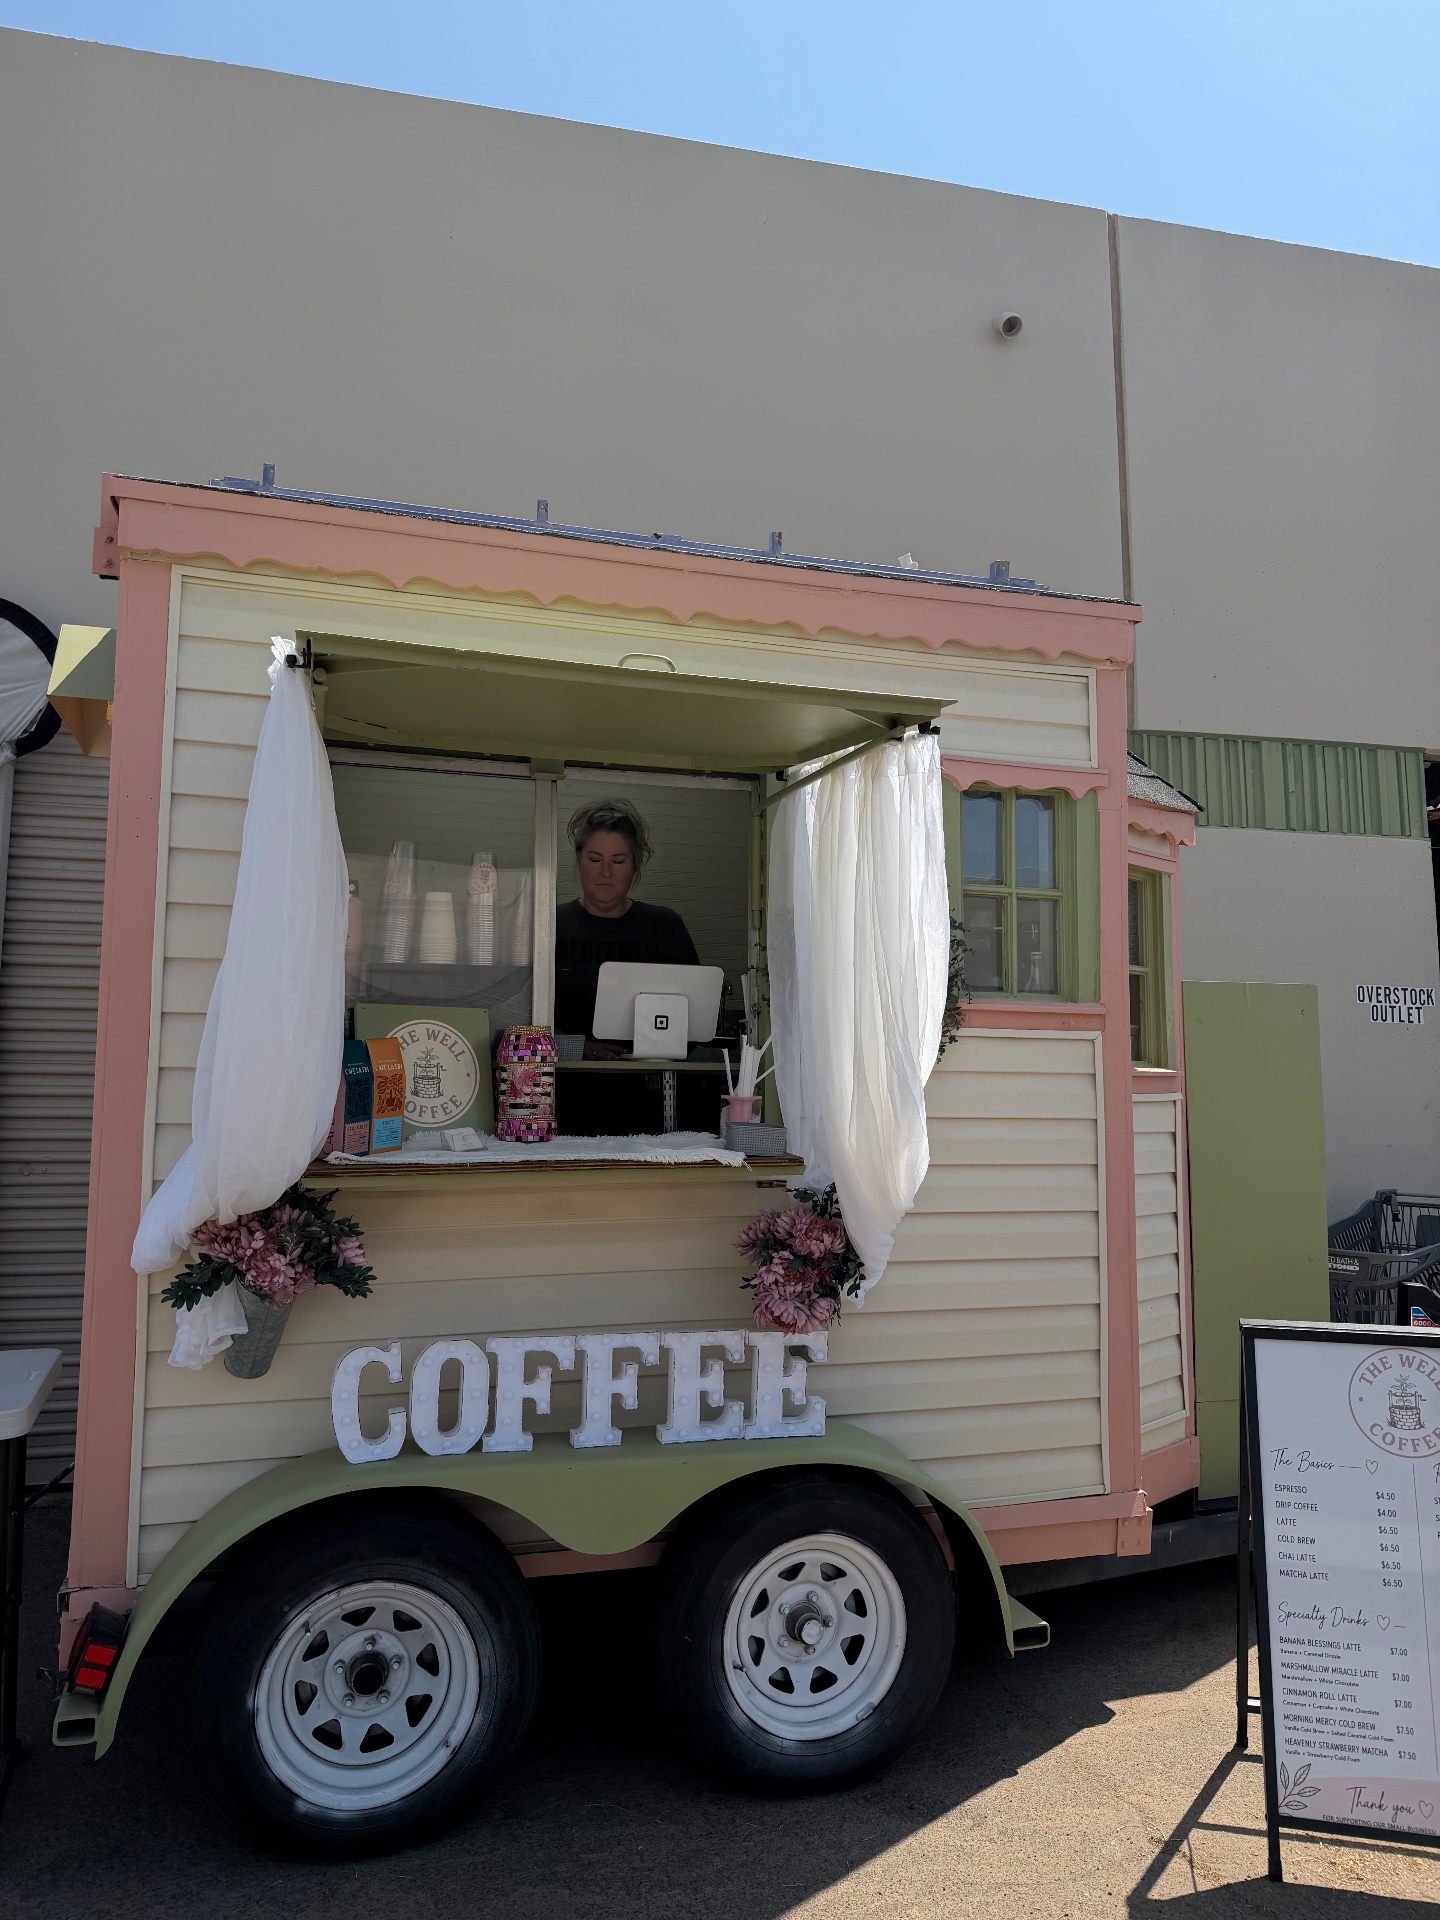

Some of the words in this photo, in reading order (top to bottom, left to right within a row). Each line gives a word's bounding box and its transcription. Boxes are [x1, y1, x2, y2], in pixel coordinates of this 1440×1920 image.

[1357, 985, 1434, 1006] OVERSTOCK
[1371, 1004, 1423, 1024] OUTLET
[399, 1029, 420, 1051] HE
[425, 1027, 466, 1062] WELL
[404, 1094, 463, 1119] OFFEE
[1336, 1256, 1353, 1265] BATH
[1328, 1262, 1360, 1271] EYOND
[1359, 1356, 1393, 1386] THE
[331, 1329, 829, 1464] COFFEE
[1270, 1448, 1292, 1471] The
[1297, 1451, 1334, 1472] Basics
[1274, 1484, 1307, 1494] ESPRESSO
[1375, 1491, 1395, 1500] $4.50
[1276, 1500, 1291, 1509] DRIP
[1294, 1502, 1318, 1512] COFFEE
[1377, 1508, 1396, 1518] $4.00
[1276, 1518, 1297, 1526] LATTE
[1378, 1526, 1398, 1535] $6.50
[1278, 1534, 1295, 1544] COLD
[1297, 1536, 1316, 1545] BREW
[1380, 1543, 1400, 1552] $6.50
[1278, 1552, 1295, 1560] CHAI
[1296, 1553, 1316, 1562] LATTE
[1381, 1560, 1401, 1570] $6.50
[1279, 1569, 1307, 1579] MATCHA
[1309, 1572, 1329, 1581] LATTE
[1382, 1578, 1402, 1587] $6.50
[1278, 1600, 1327, 1629] Specialty
[1330, 1606, 1369, 1628] Drinks
[1279, 1635, 1306, 1645] BANANA
[1307, 1639, 1340, 1650] BLESSINGS
[1342, 1642, 1362, 1652] LATTE
[1390, 1647, 1408, 1656] $7.00
[1280, 1661, 1330, 1674] MARSHMALLOW
[1331, 1666, 1358, 1676] MIRACLE
[1359, 1669, 1378, 1679] LATTE
[1392, 1672, 1410, 1682] $7.00
[1282, 1687, 1317, 1699] CINNAMON
[1319, 1691, 1336, 1701] ROLL
[1337, 1693, 1357, 1703] LATTE
[1394, 1699, 1412, 1709] $7.00
[1283, 1713, 1313, 1724] MORNING
[1315, 1717, 1337, 1727] MERCY
[1339, 1719, 1356, 1729] COLD
[1357, 1722, 1376, 1731] BREW
[1396, 1725, 1414, 1736] $7.50
[1284, 1737, 1316, 1749] HEAVENLY
[1318, 1741, 1359, 1754] STRAWBERRY
[1362, 1746, 1388, 1757] MATCHA
[1398, 1750, 1416, 1760] $7.50
[1346, 1786, 1388, 1814] Thank
[1392, 1804, 1415, 1823] you
[1336, 1816, 1372, 1827] SUPPORTING
[1387, 1823, 1407, 1831] SMALL
